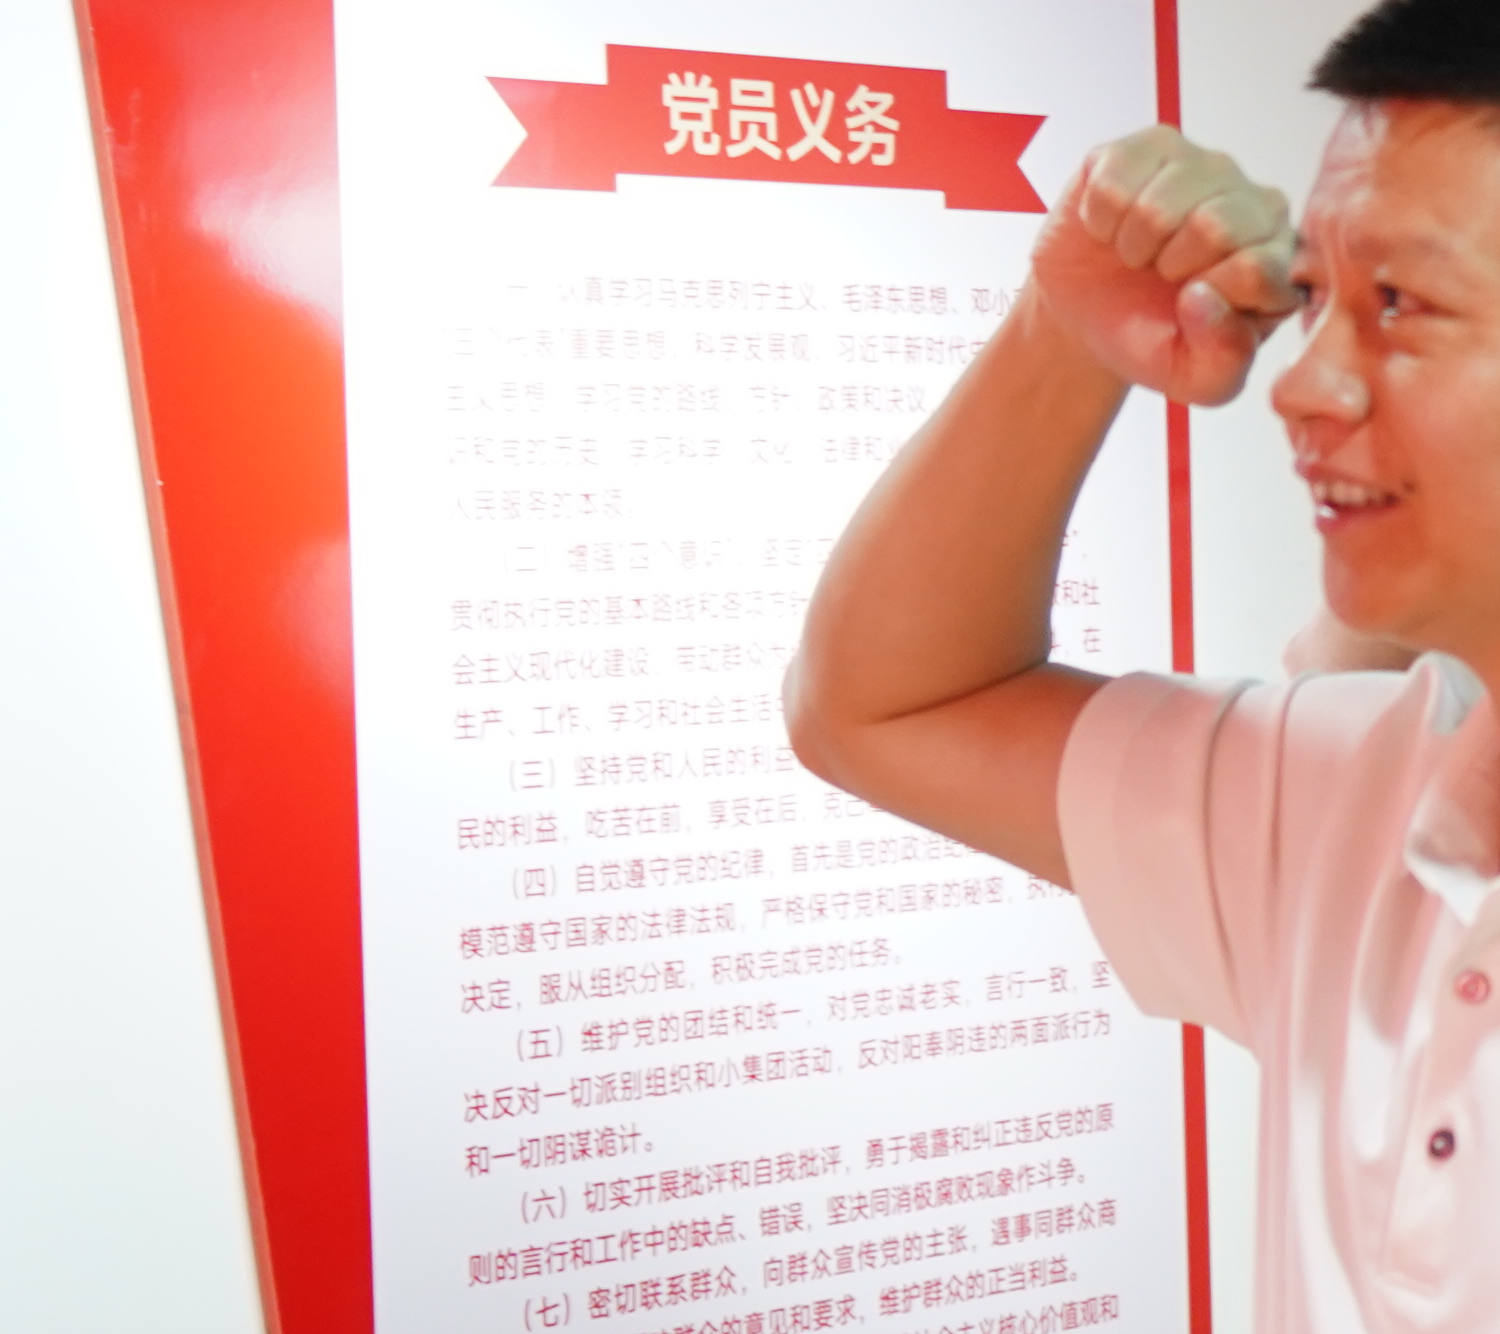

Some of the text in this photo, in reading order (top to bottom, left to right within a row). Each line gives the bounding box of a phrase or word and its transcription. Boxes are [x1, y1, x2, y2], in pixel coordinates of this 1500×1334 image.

[660, 71, 901, 166] 党员义务
[457, 789, 886, 851] 民的利益，吃苦在前，享受在后，克己
[512, 834, 986, 900] （四）自觉遵守党的纪律，首先是党的政治纪
[464, 1122, 656, 1179] 和一切阴谋诡计。
